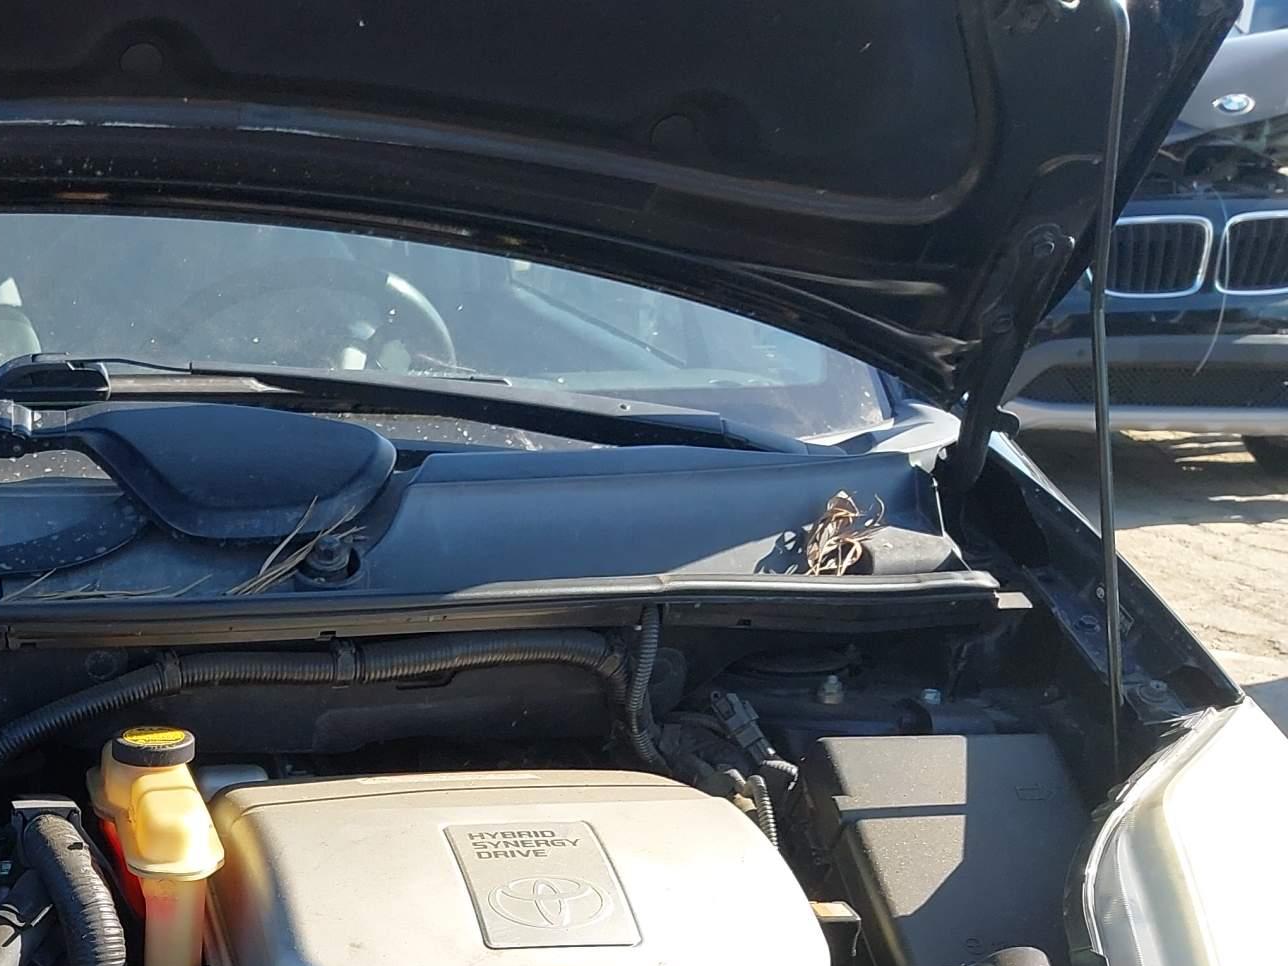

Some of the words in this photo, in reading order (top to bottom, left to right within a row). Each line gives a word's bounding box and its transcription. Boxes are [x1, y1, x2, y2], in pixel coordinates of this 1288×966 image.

[467, 830, 556, 840] HYBRID
[472, 839, 580, 849] SYNERGY
[476, 850, 548, 859] DRIVE
